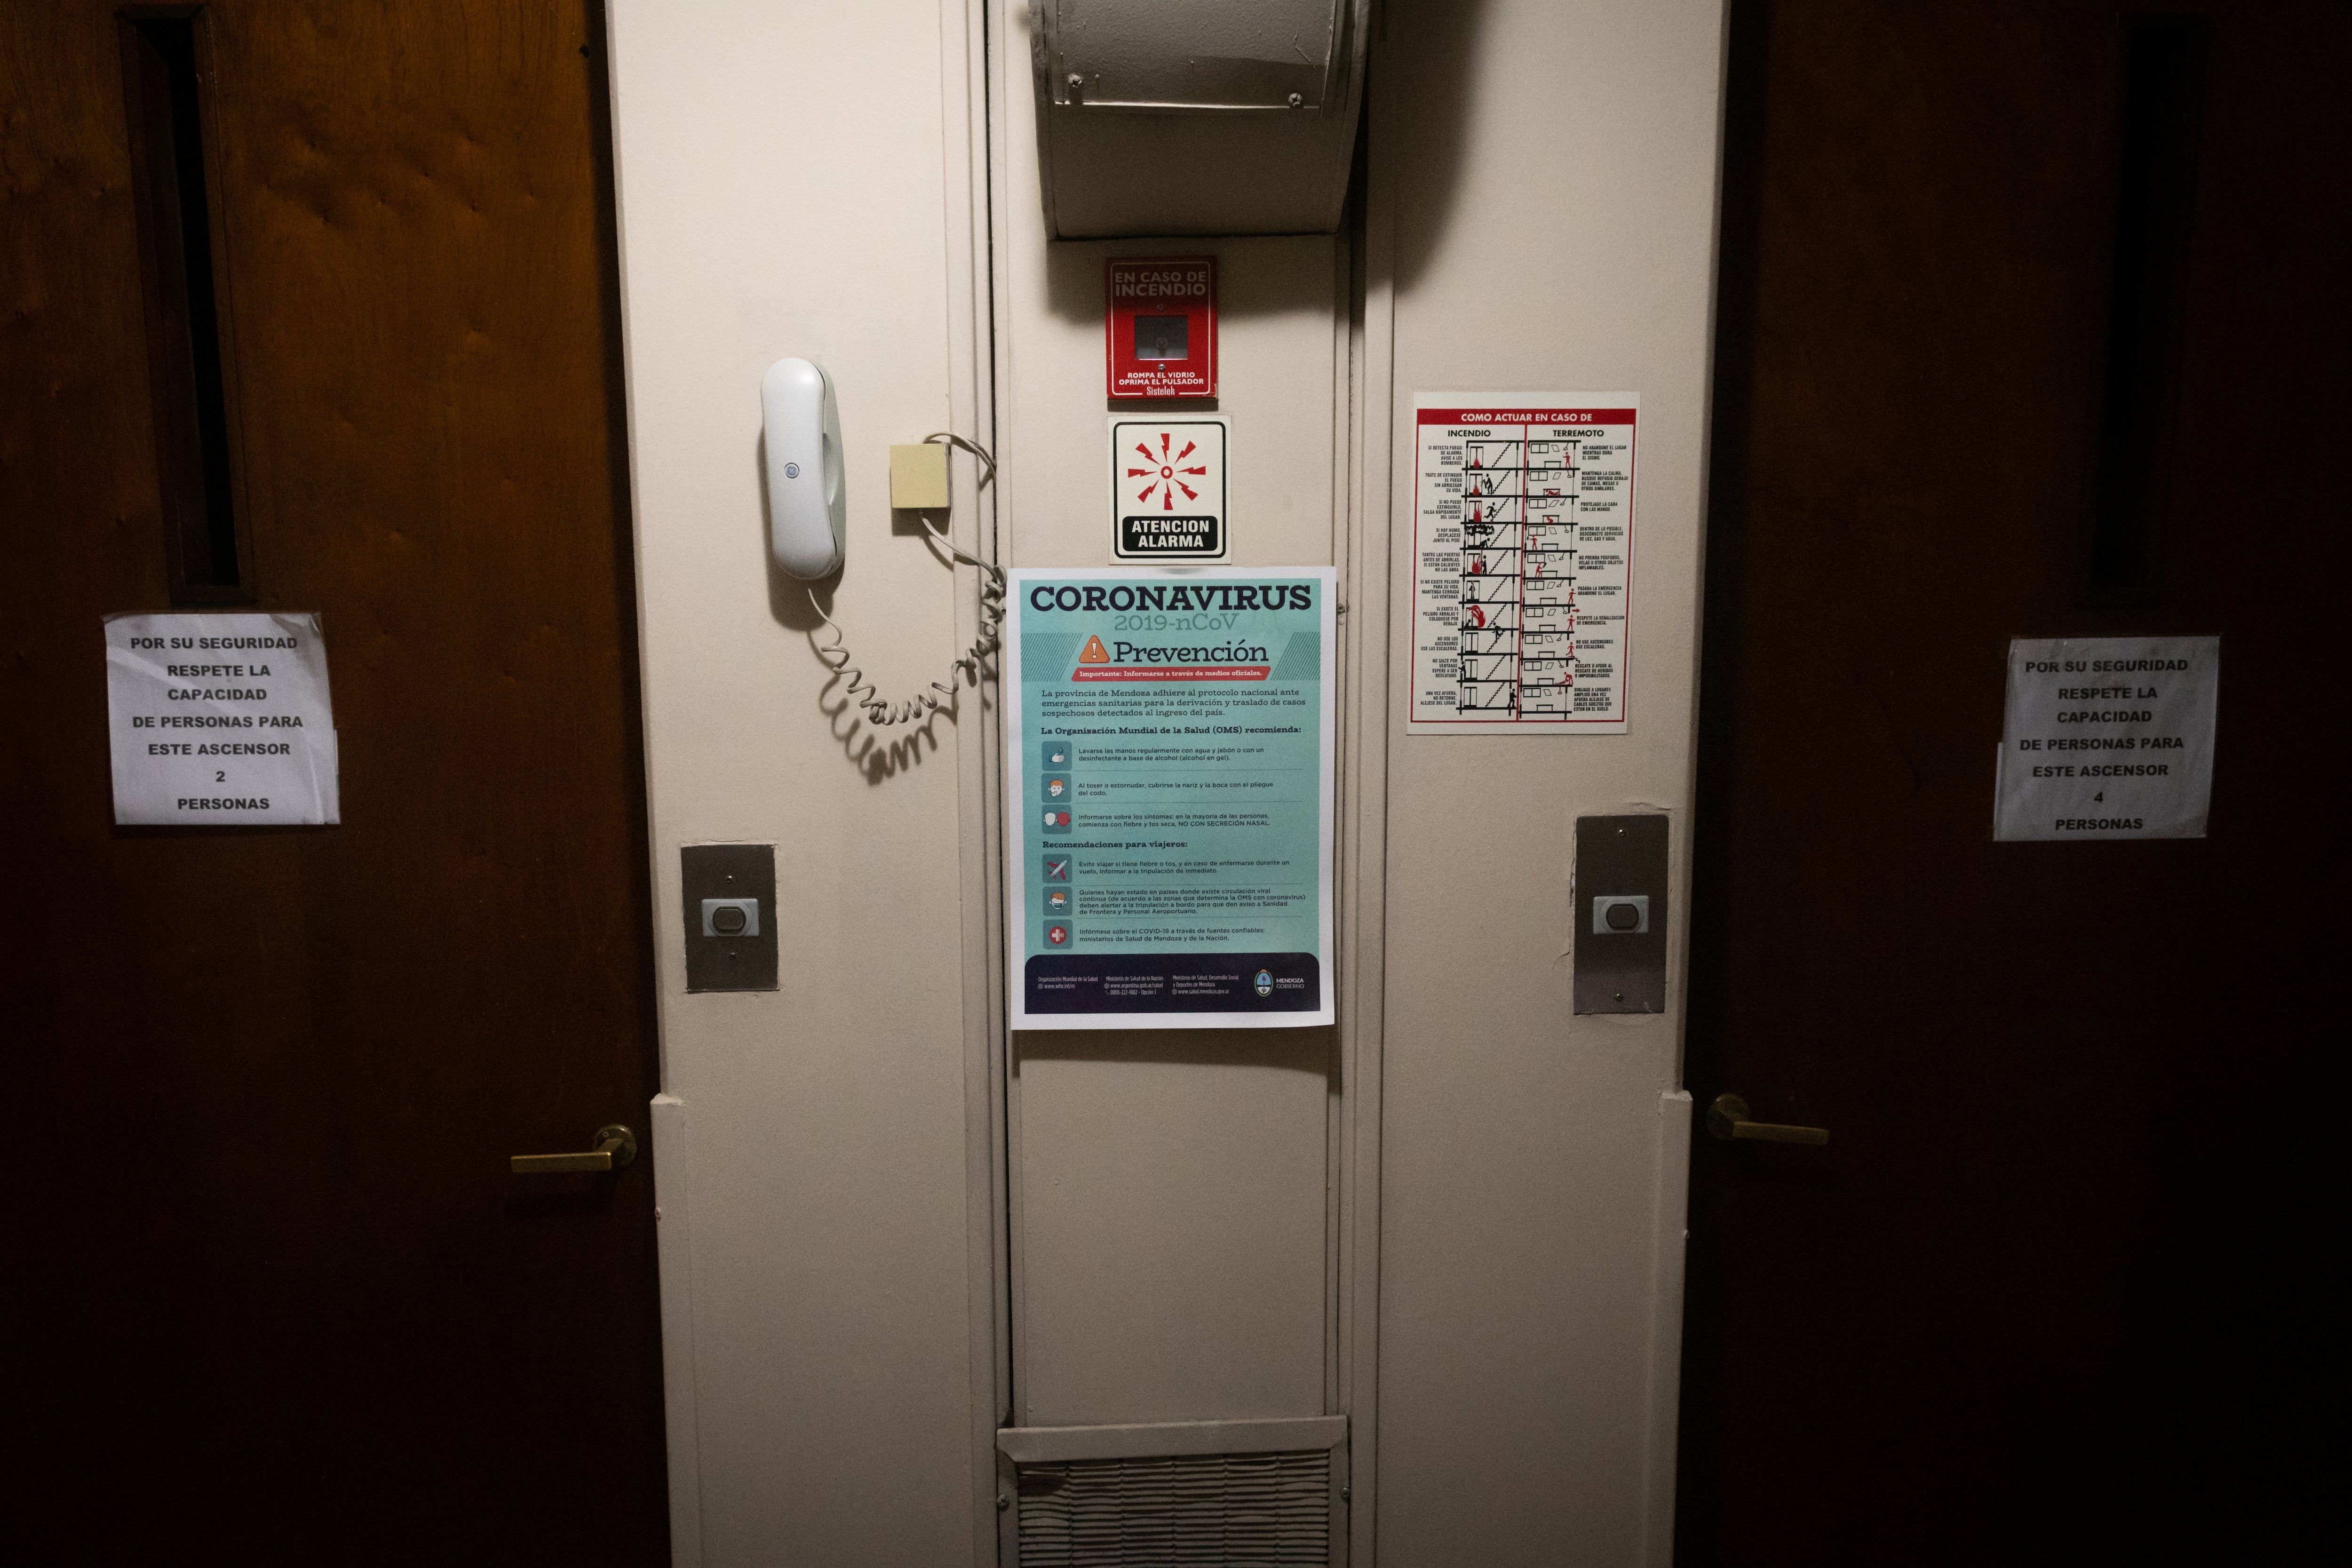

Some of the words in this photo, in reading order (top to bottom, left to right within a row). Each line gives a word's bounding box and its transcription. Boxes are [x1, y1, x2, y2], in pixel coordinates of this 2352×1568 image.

[1115, 272, 1135, 283] EN
[1140, 272, 1181, 282] CASO
[1187, 271, 1206, 282] DE
[1115, 283, 1205, 295] INCENDIO
[1147, 386, 1175, 395] Sistelek
[1132, 520, 1208, 532] ATENCION
[1138, 535, 1203, 547] ALARMA
[1031, 585, 1311, 611] CORONAVIRUS
[1114, 613, 1239, 631] 2019-nCoV
[130, 637, 165, 649] POR
[171, 637, 193, 648] SU
[199, 637, 297, 648] SEGURIDAD
[1113, 639, 1269, 662] Prevención
[167, 665, 243, 676] RESPETE
[249, 665, 270, 676] LA
[2026, 661, 2059, 672] POR
[2064, 661, 2086, 672] SU
[2092, 659, 2188, 672] SEGURIDAD
[167, 689, 266, 700] CAPACIDAD
[1055, 690, 1096, 698] provincia
[2058, 686, 2132, 699] RESPETE
[2137, 687, 2157, 698] LA
[1205, 708, 1225, 717] país.
[2057, 711, 2152, 722] CAPACIDAD
[133, 716, 155, 727] DE
[161, 716, 253, 727] PERSONAS
[259, 716, 302, 727] PARA
[1055, 727, 1116, 735] Organización
[1213, 725, 1242, 734] (OMS)
[148, 744, 191, 755] ESTE
[198, 743, 290, 755] ASCENSOR
[2020, 740, 2041, 750] DE
[2048, 738, 2135, 750] PERSONAS
[2140, 737, 2184, 748] PARA
[216, 771, 225, 782] 2
[2033, 766, 2074, 777] ESTE
[2079, 764, 2168, 776] ASCENSOR
[178, 798, 269, 809] PERSONAS
[2094, 792, 2103, 803] 4
[2055, 819, 2143, 829] PERSONAS
